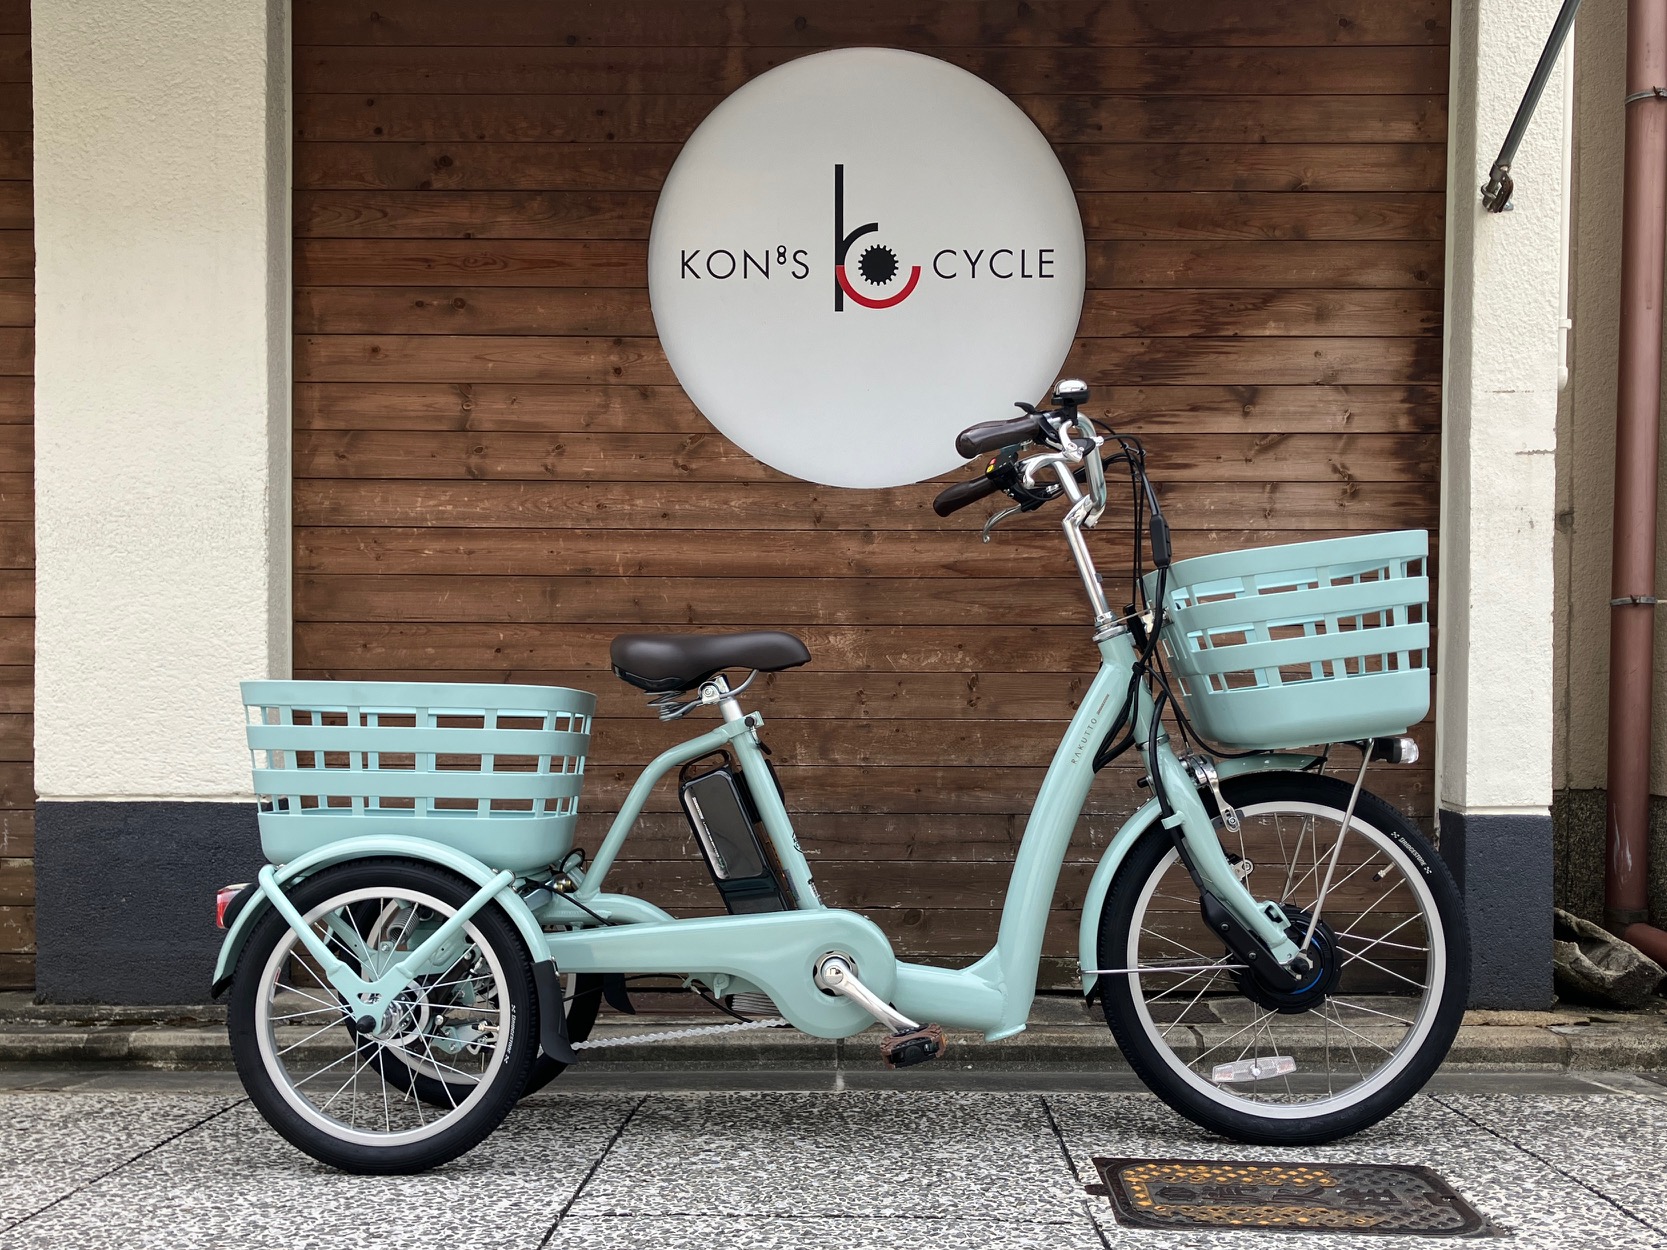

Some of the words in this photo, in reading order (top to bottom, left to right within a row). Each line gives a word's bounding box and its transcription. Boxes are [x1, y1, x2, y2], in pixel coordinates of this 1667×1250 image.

[933, 248, 1055, 280] CYCLE
[1071, 717, 1098, 765] RAKUTTO
[1398, 837, 1427, 867] BRIDGESTONE
